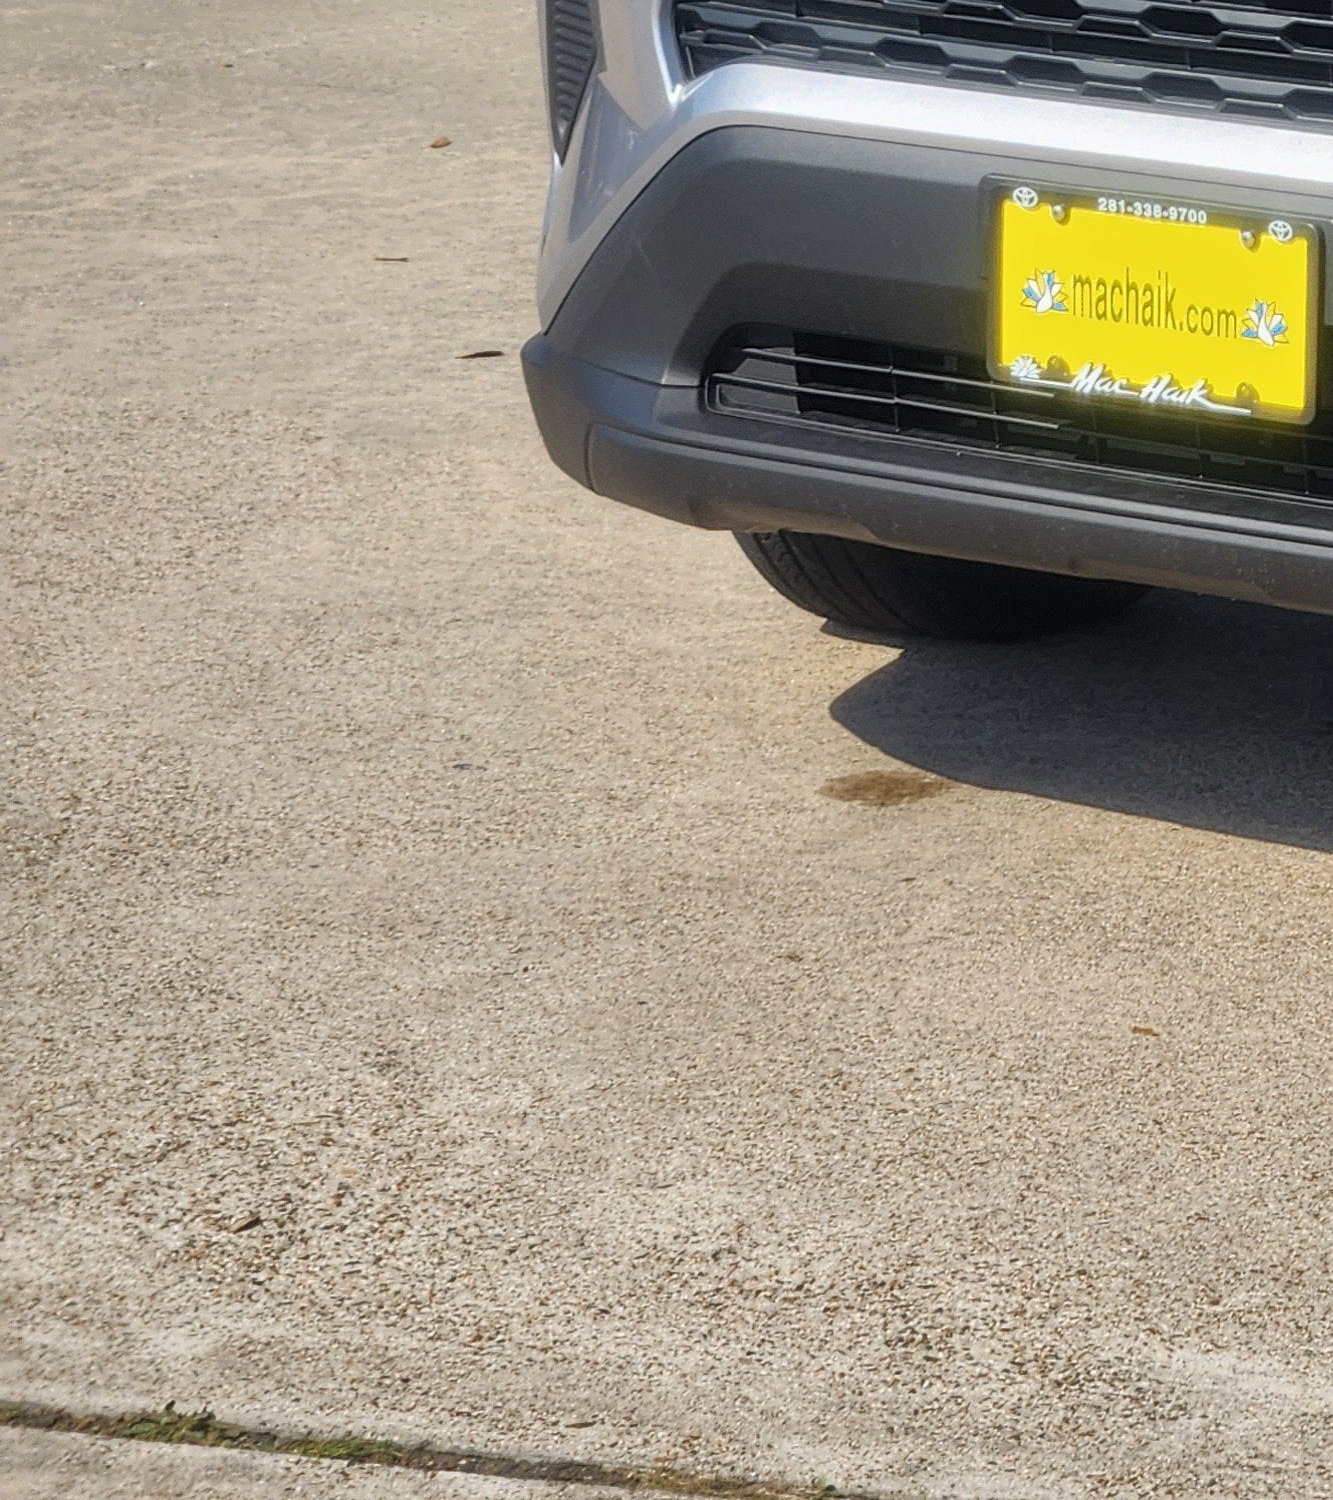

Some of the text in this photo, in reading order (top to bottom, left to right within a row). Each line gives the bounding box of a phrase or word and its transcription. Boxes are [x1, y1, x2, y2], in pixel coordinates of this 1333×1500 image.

[1097, 197, 1208, 225] 281-338-9700
[1071, 266, 1238, 340] machaik.com
[1059, 361, 1224, 410] Mac Haik
